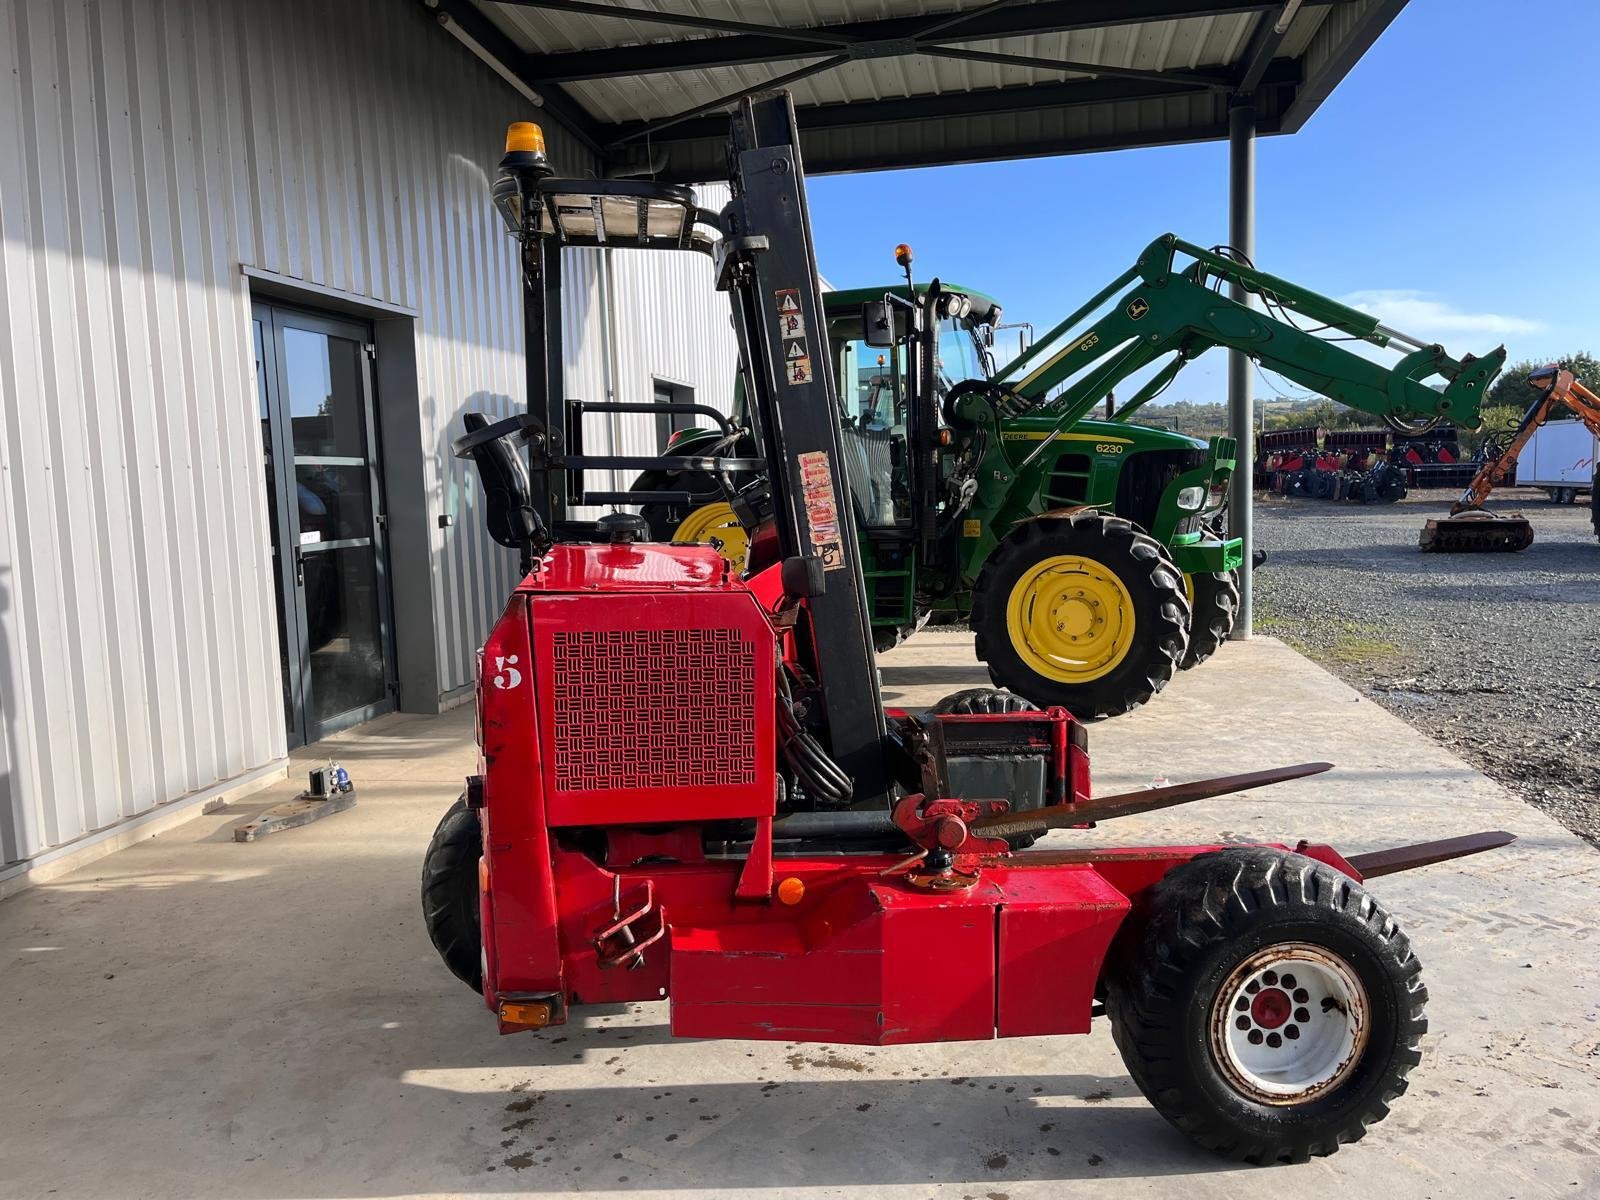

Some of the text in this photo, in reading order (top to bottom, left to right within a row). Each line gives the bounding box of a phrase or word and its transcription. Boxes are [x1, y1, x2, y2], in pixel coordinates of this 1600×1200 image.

[1081, 335, 1099, 351] 633
[1096, 444, 1123, 454] 6230
[493, 654, 522, 690] 5
